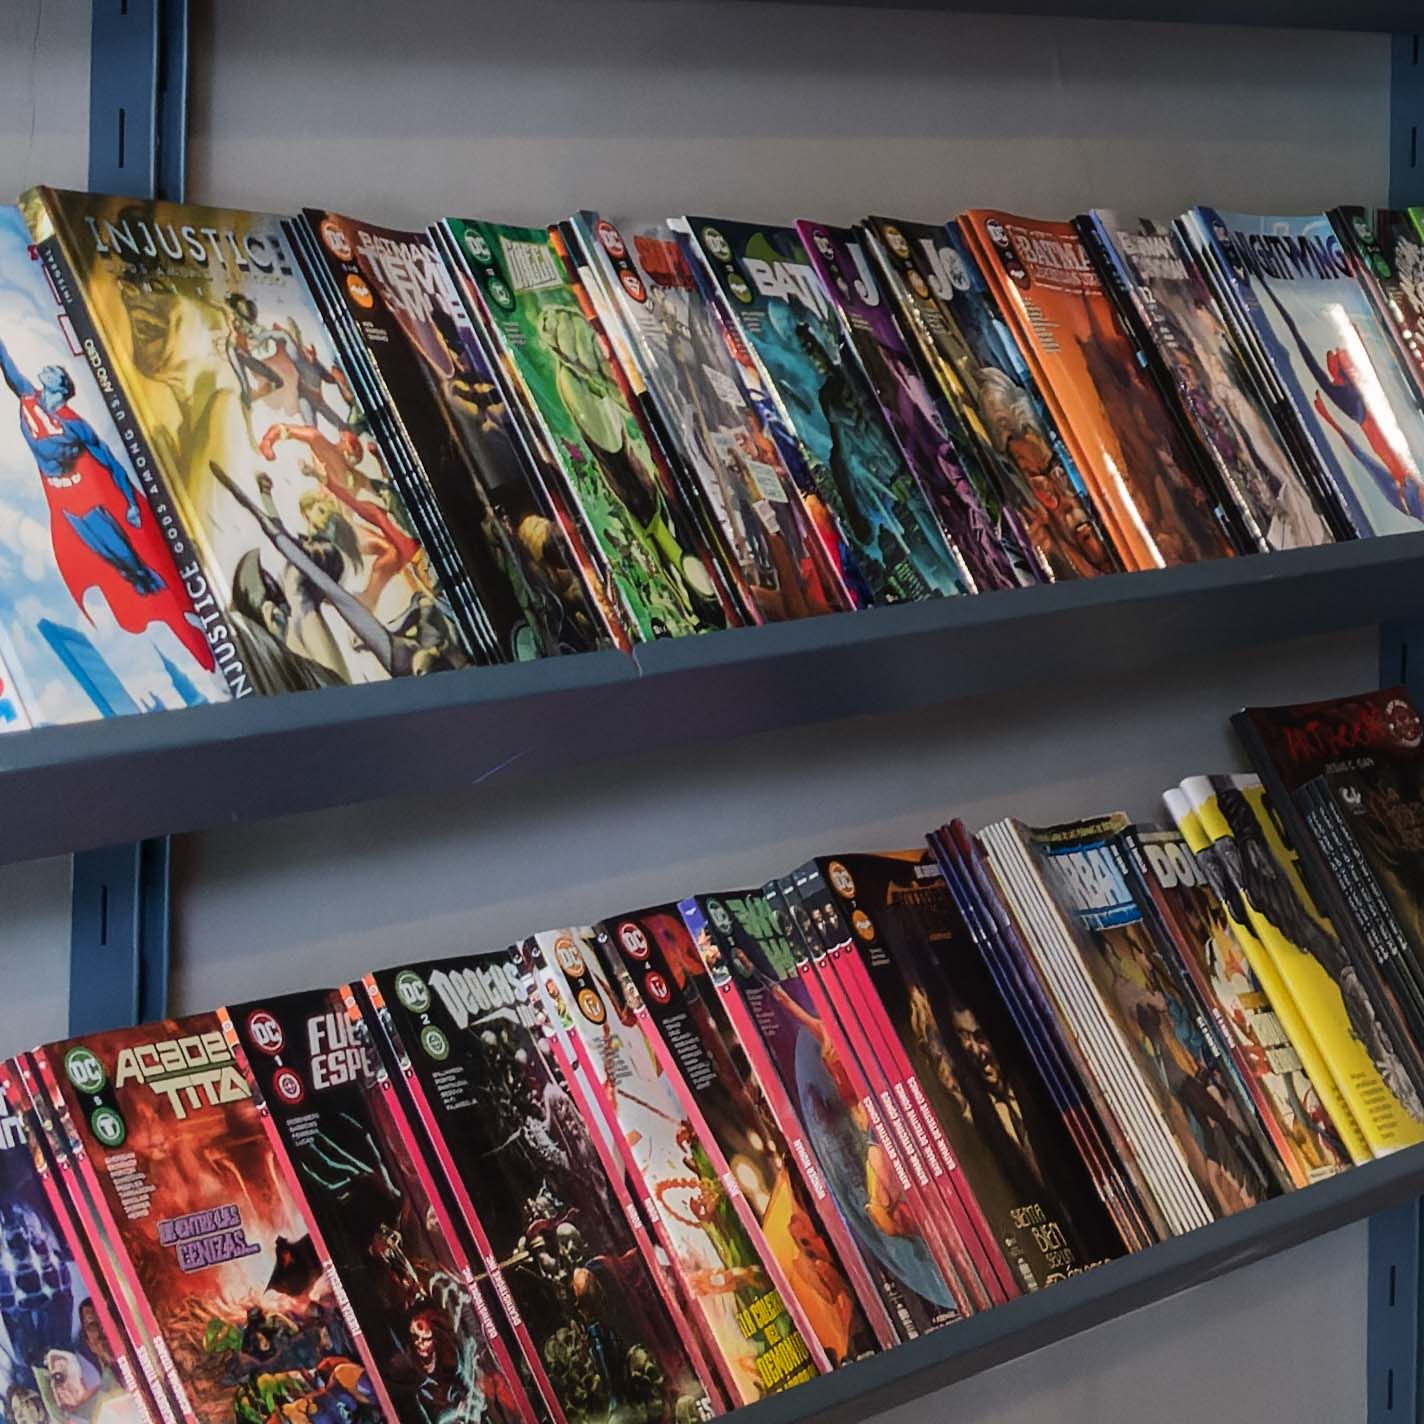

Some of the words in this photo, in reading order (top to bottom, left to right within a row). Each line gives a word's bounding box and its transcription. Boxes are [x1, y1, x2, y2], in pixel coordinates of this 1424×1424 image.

[357, 230, 440, 264] BATMAN
[1234, 230, 1355, 281] NIGHTWING
[93, 366, 115, 394] AÑO
[119, 427, 163, 495] AMONG
[153, 501, 187, 554] GODS
[399, 980, 427, 1005] DC
[420, 1012, 431, 1025] 2
[251, 1022, 283, 1050] DC
[70, 1058, 100, 1088] DC
[905, 1075, 925, 1104] COMICS
[862, 1095, 882, 1124] COMICS
[879, 1090, 899, 1120] COMICS
[892, 1082, 913, 1111] COMICS
[891, 1117, 916, 1155] DETECTIVE
[904, 1108, 930, 1146] DETECTIVE
[918, 1102, 942, 1139] DETECTIVE
[791, 1138, 812, 1169] WOMAN
[874, 1122, 898, 1159] DETECTIVE
[805, 1166, 827, 1200] WONDER
[467, 1281, 500, 1339] DEATHSTROKE
[490, 1269, 524, 1326] DEATHSTROKE
